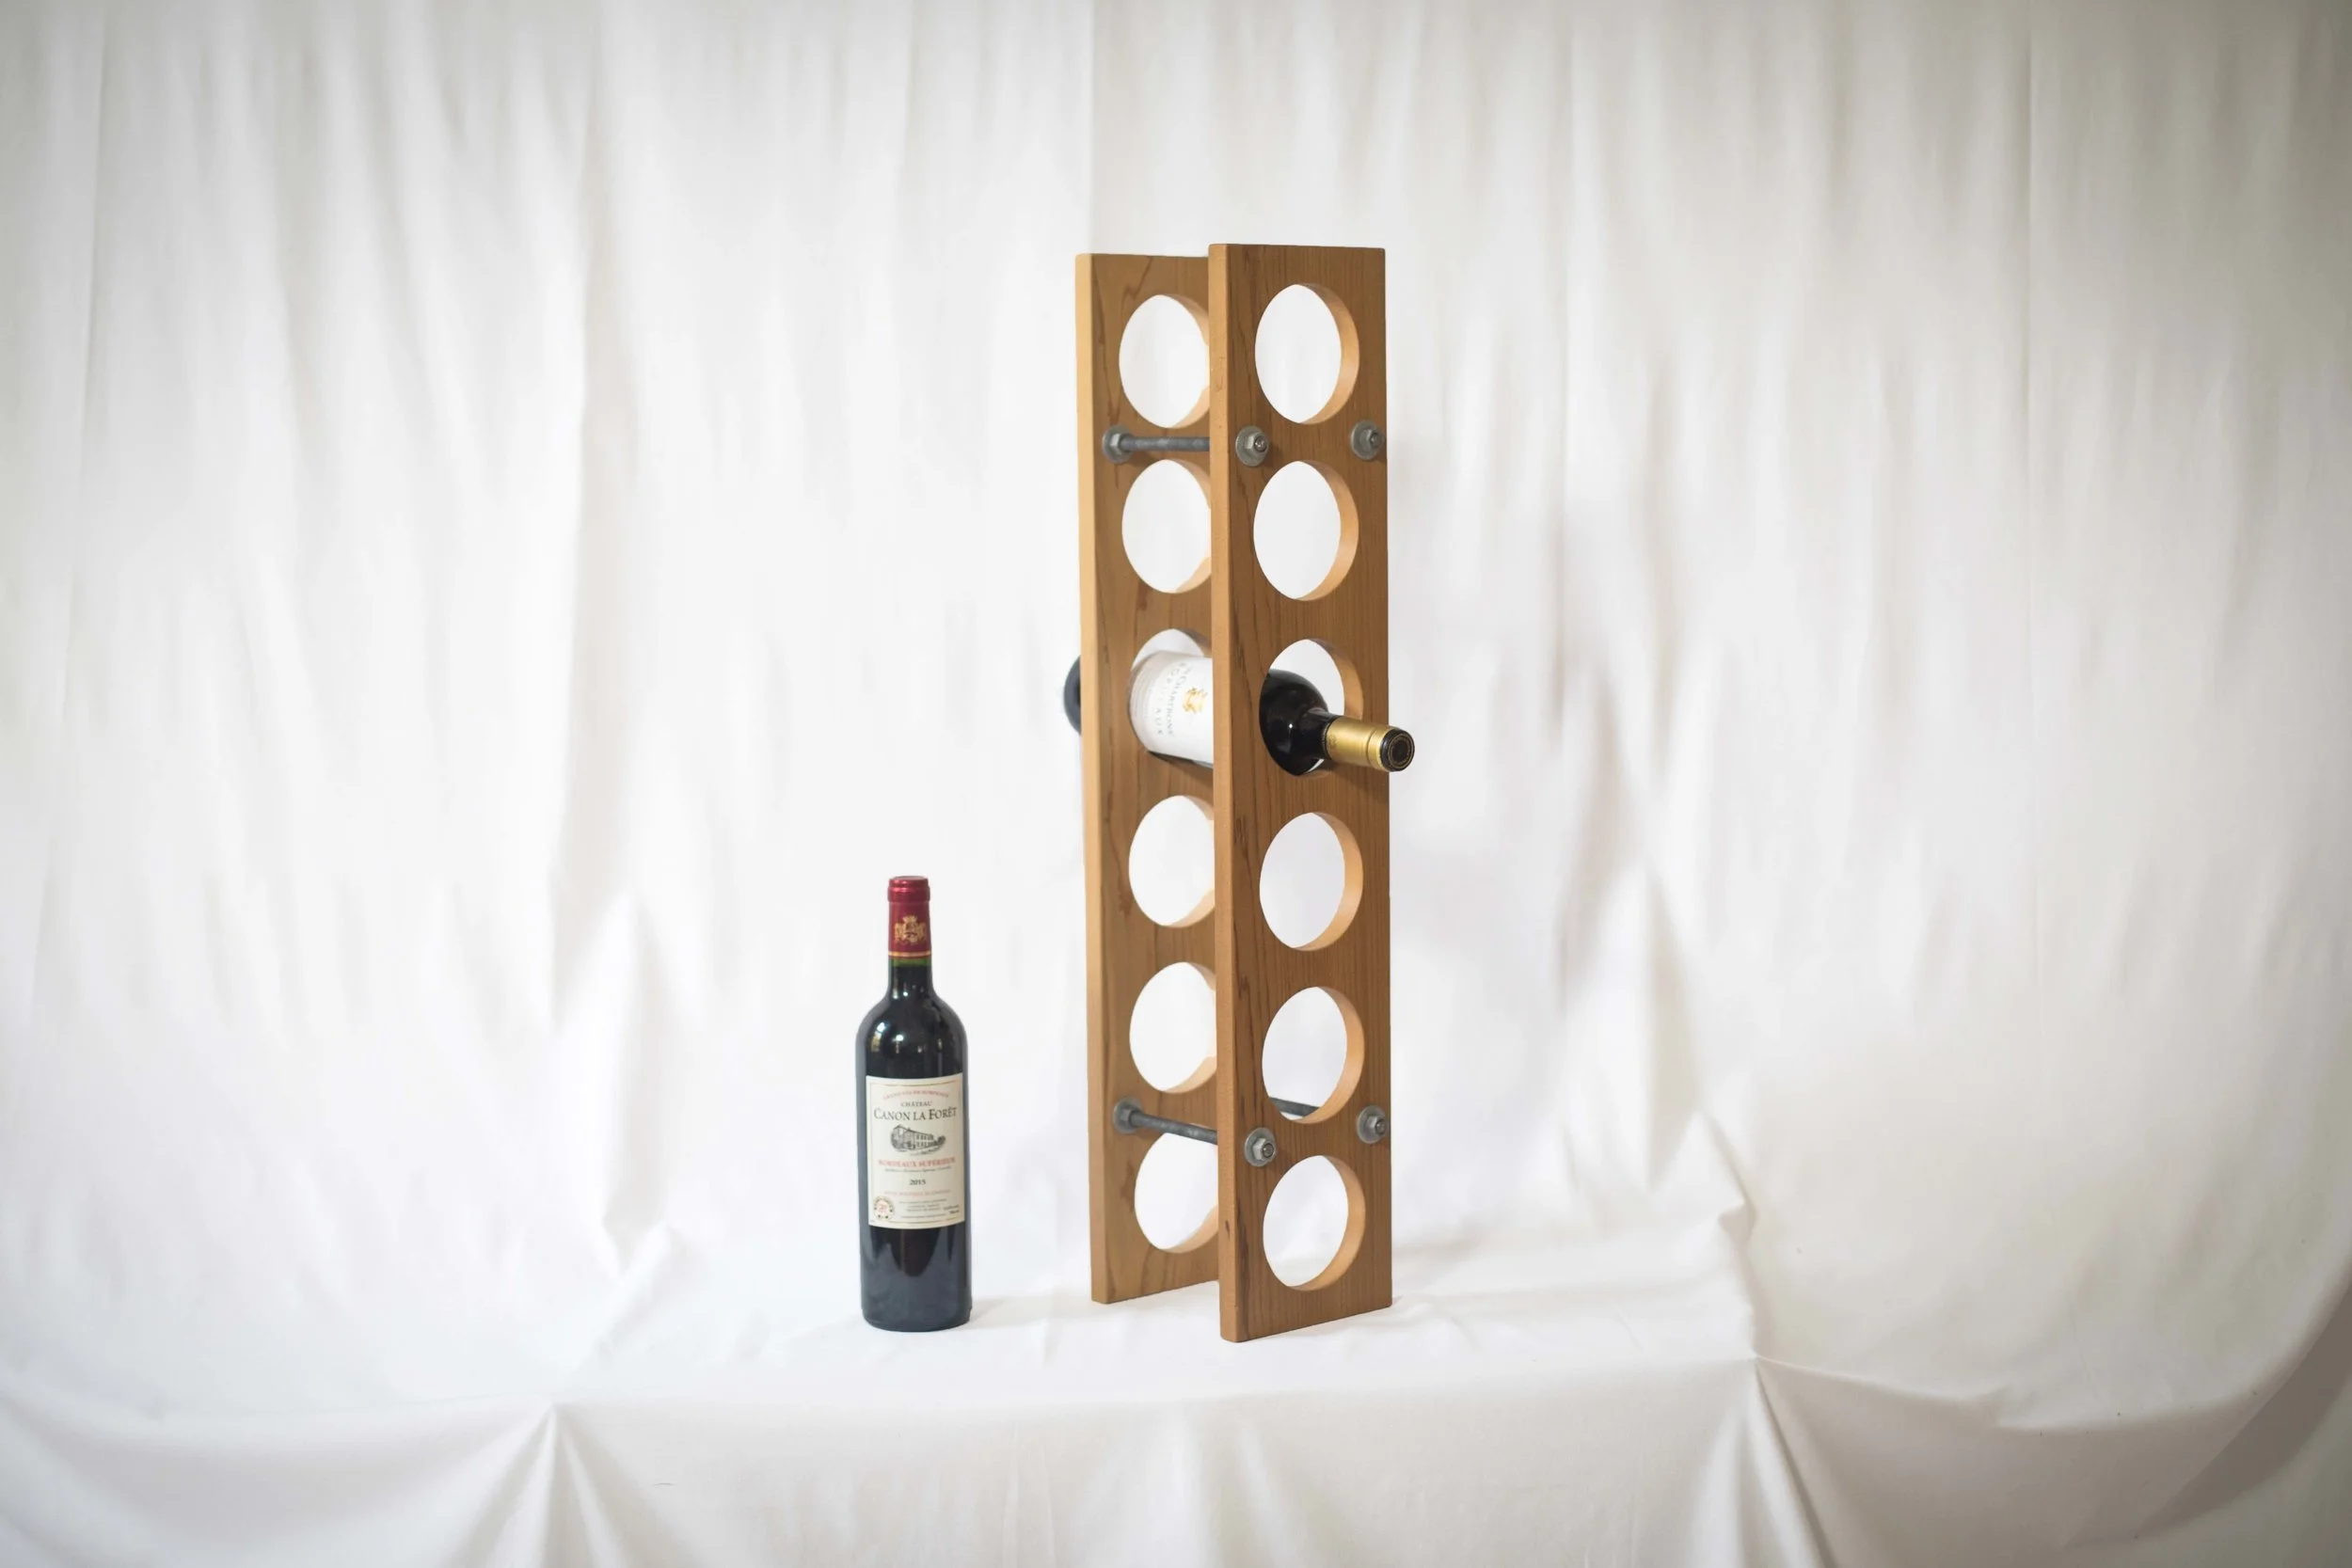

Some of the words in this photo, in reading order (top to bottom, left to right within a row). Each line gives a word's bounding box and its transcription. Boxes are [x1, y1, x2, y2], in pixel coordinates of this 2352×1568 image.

[873, 1107, 910, 1121] CANON
[913, 1111, 926, 1121] LA
[928, 1106, 958, 1120] FORÊT
